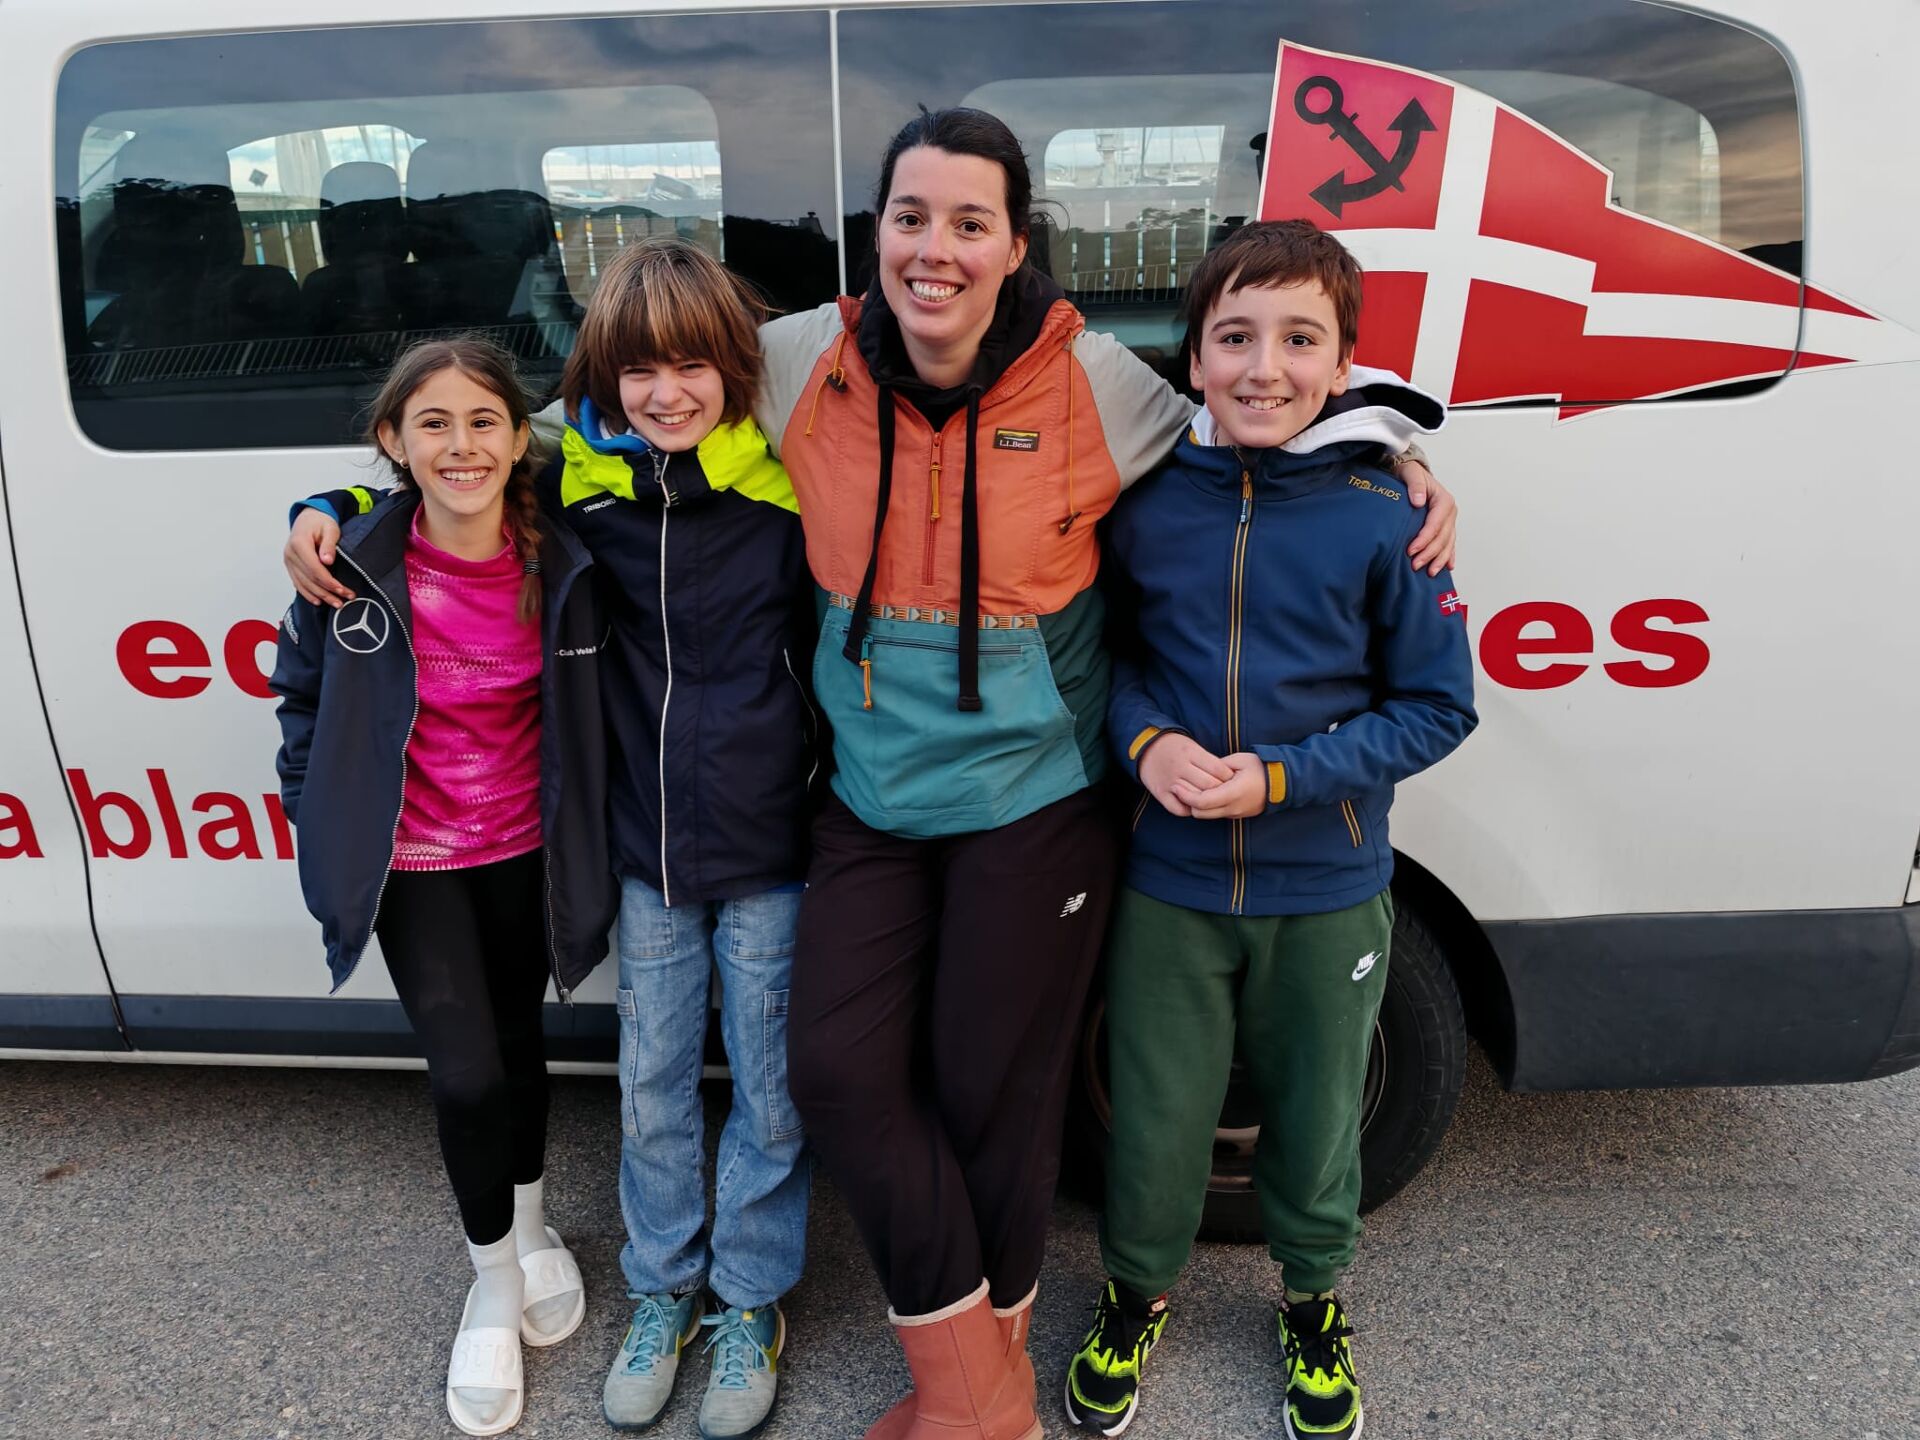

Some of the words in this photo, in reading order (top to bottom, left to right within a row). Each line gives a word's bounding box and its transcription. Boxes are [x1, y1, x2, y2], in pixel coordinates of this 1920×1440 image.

[999, 439, 1032, 449] L.L.Bean
[1347, 474, 1402, 502] TROLLKIDS
[1460, 598, 1711, 691] es
